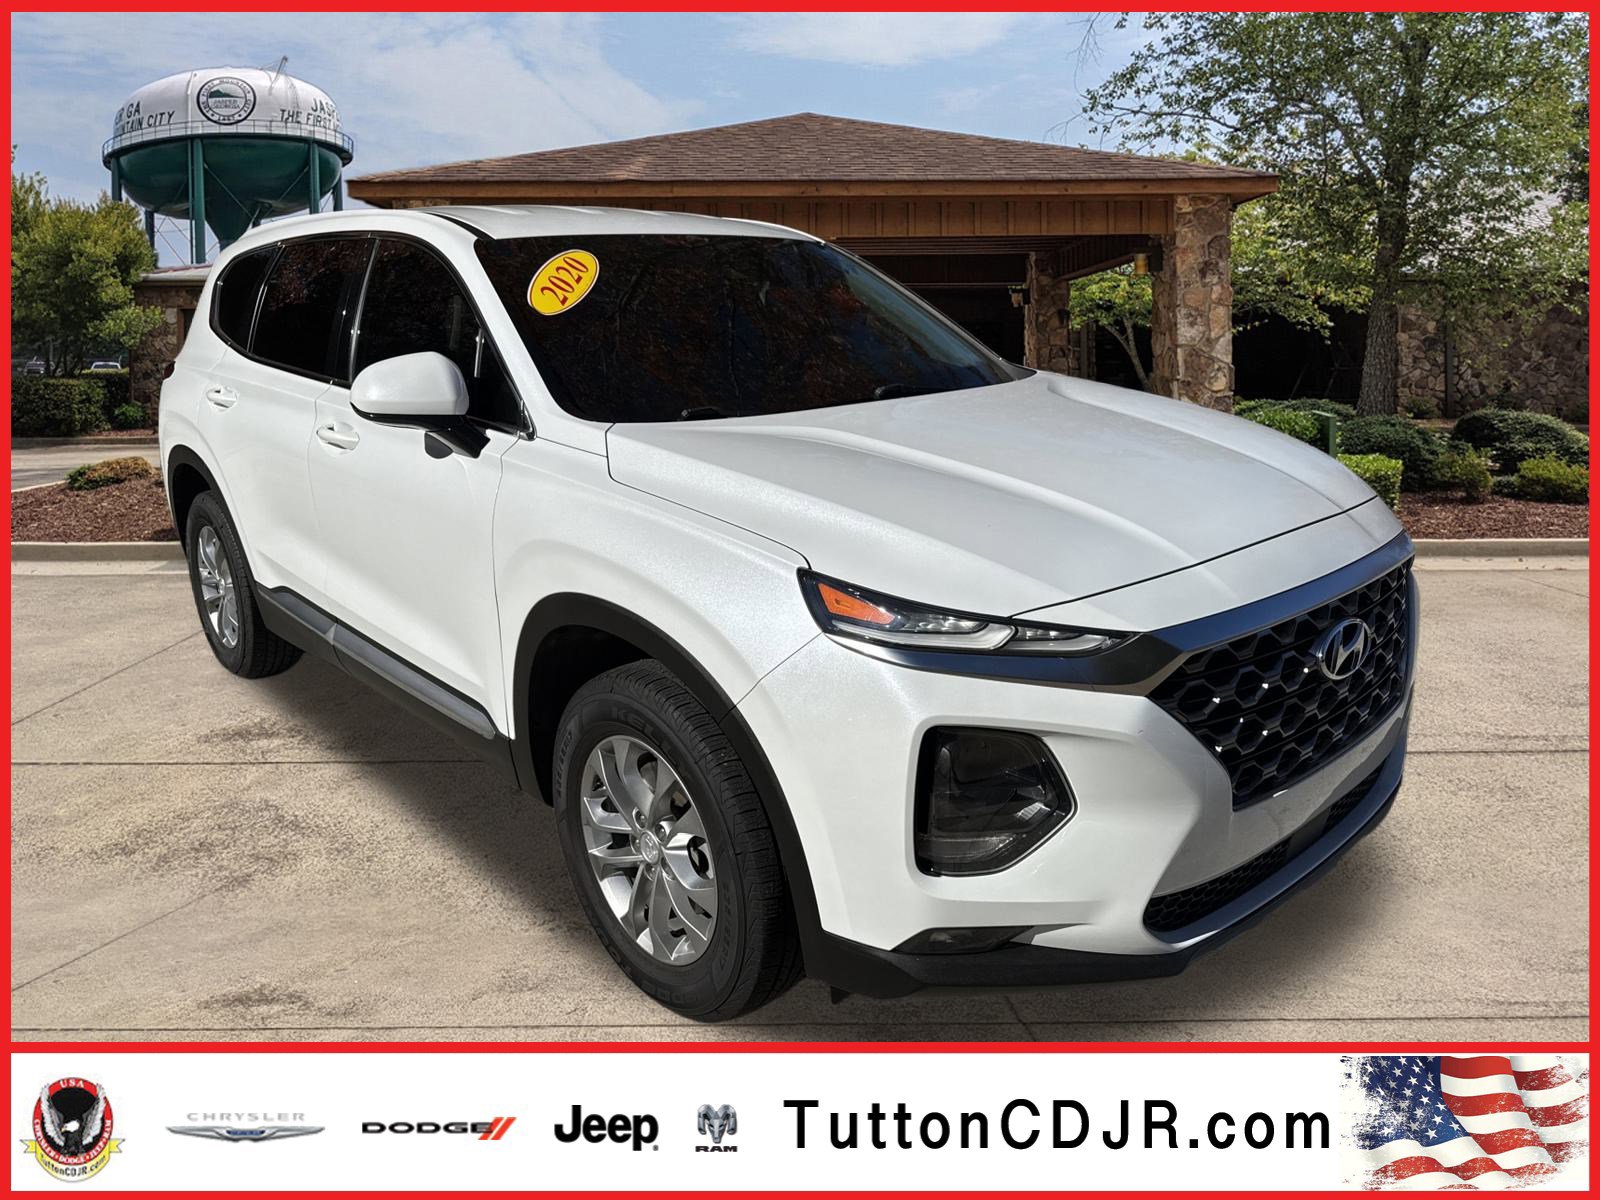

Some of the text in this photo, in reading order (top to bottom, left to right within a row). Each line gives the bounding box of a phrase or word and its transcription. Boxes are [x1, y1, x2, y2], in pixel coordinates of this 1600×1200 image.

[127, 101, 141, 119] GA
[147, 110, 175, 127] CITY
[280, 109, 302, 124] THE
[306, 113, 332, 128] FIRST
[540, 256, 589, 306] 2020
